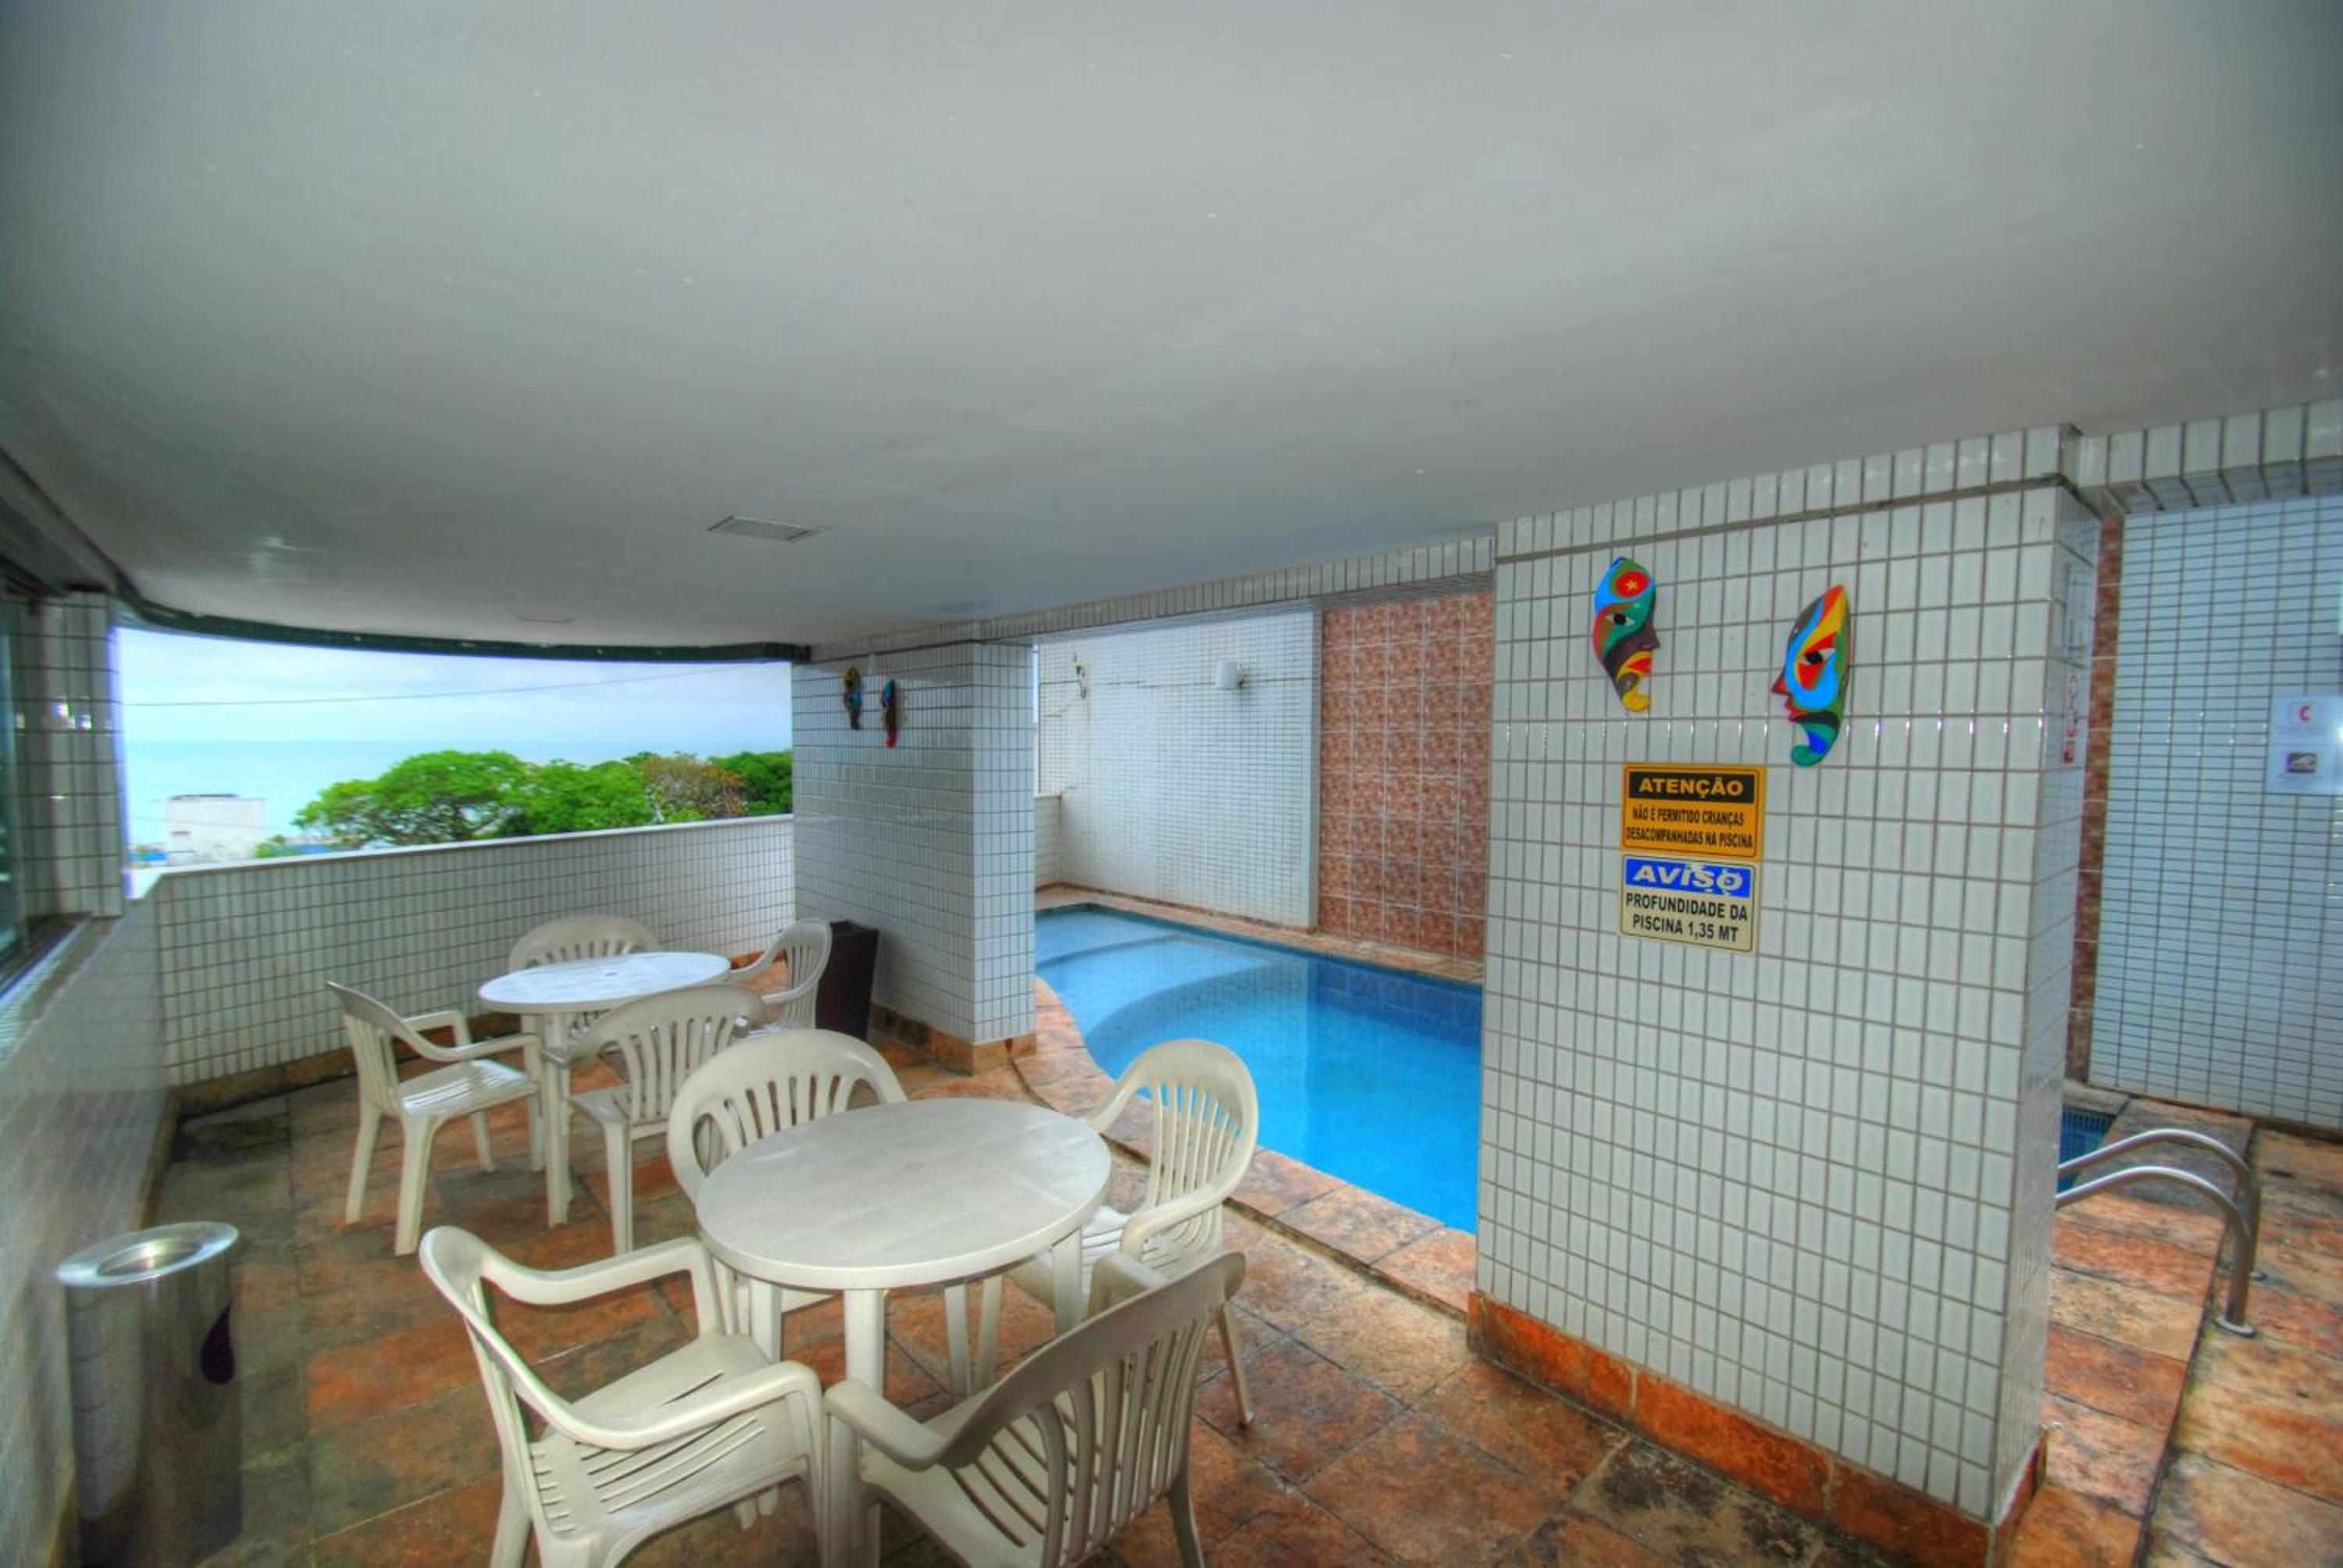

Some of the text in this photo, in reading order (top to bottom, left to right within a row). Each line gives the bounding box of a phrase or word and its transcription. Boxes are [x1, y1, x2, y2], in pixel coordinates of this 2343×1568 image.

[1639, 776, 1744, 799] ATENÇÃO
[1657, 807, 1700, 823] PERMITIDO
[1703, 810, 1744, 829] CRIANÇAS
[1625, 826, 1753, 849] DESACOMPANHADAS NA PISCINA
[1633, 864, 1743, 892] AVISO
[1626, 893, 1748, 921] PROFUNDIDADE DA
[1633, 914, 1739, 943] PISCINA 1,35 MT
